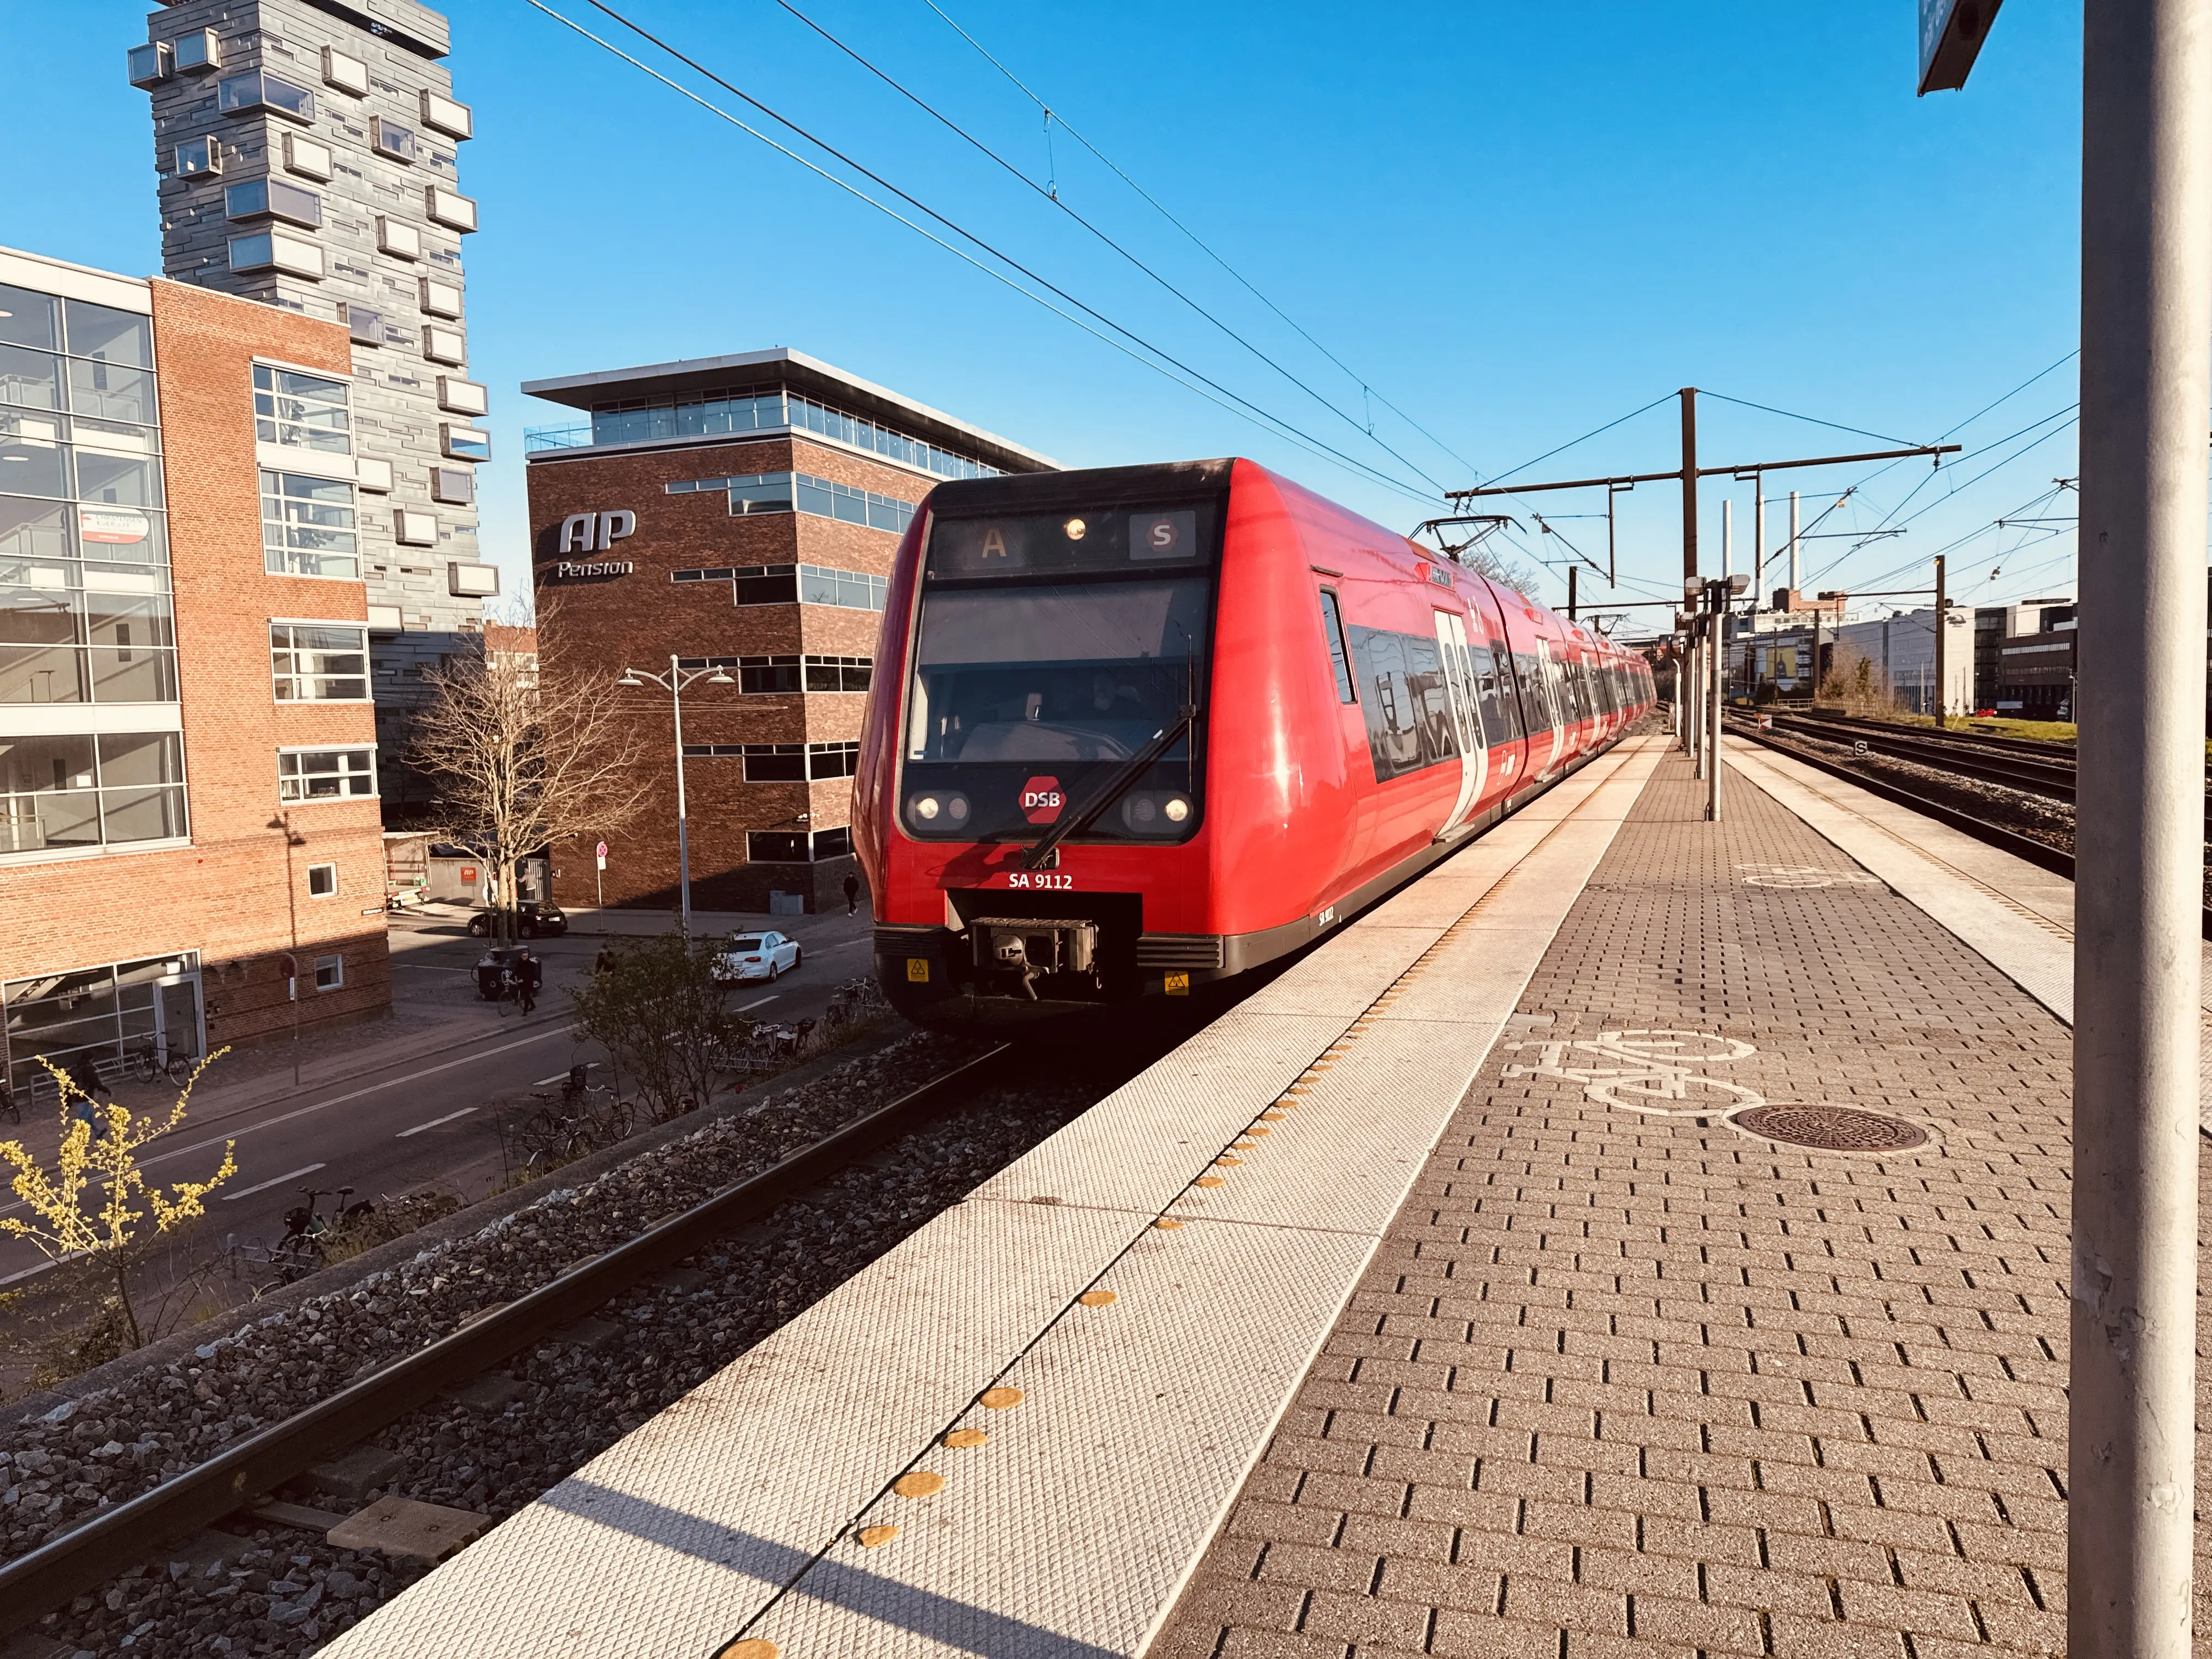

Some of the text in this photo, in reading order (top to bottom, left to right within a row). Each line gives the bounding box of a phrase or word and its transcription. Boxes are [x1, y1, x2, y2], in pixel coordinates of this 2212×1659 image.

[96, 515, 142, 523] CHRISTENSEN
[560, 509, 636, 553] AP
[1153, 524, 1171, 545] S
[981, 528, 1007, 558] A
[558, 561, 633, 578] Pension
[1857, 742, 1866, 754] S
[1025, 792, 1060, 808] DSB
[1009, 873, 1073, 889] SA 9112
